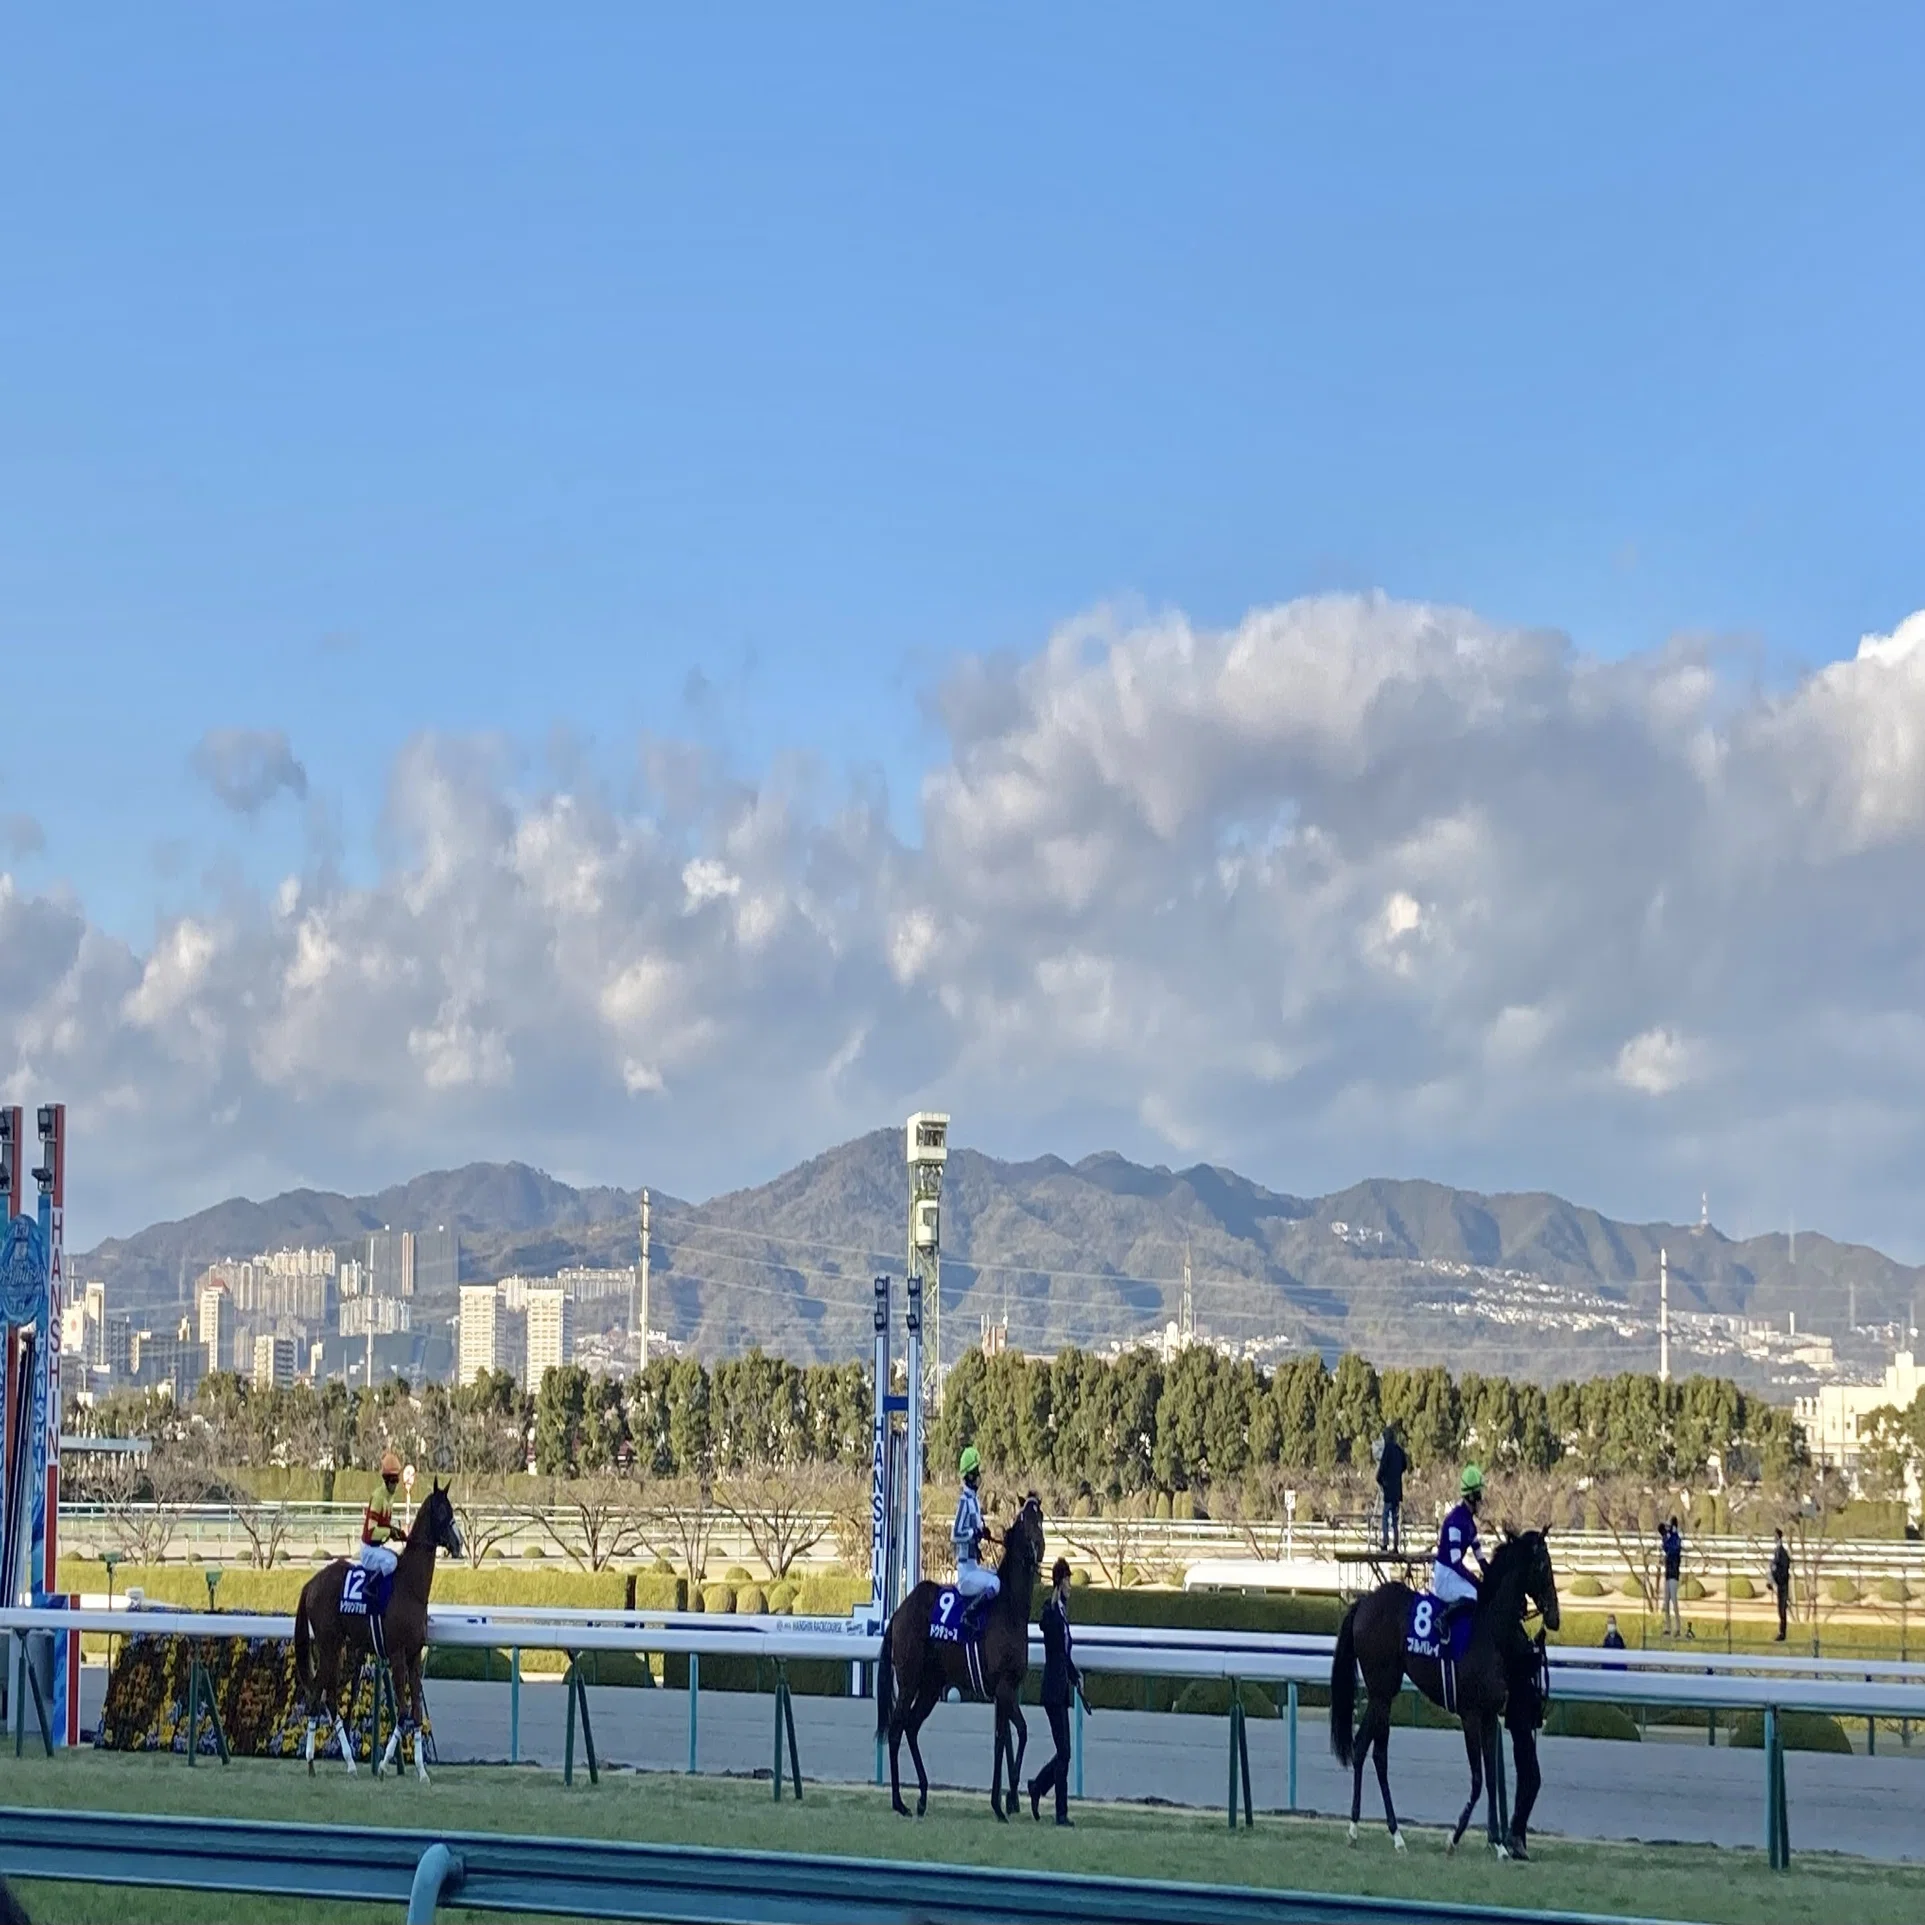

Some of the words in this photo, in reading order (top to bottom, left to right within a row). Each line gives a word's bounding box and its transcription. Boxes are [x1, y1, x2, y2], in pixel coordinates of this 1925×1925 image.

[48, 1211, 62, 1460] HANSHIN
[34, 1330, 47, 1492] HANSHIN
[872, 1416, 884, 1600] HANSHIN
[343, 1570, 366, 1600] 12
[939, 1592, 955, 1624] 9
[1414, 1600, 1432, 1638] 8
